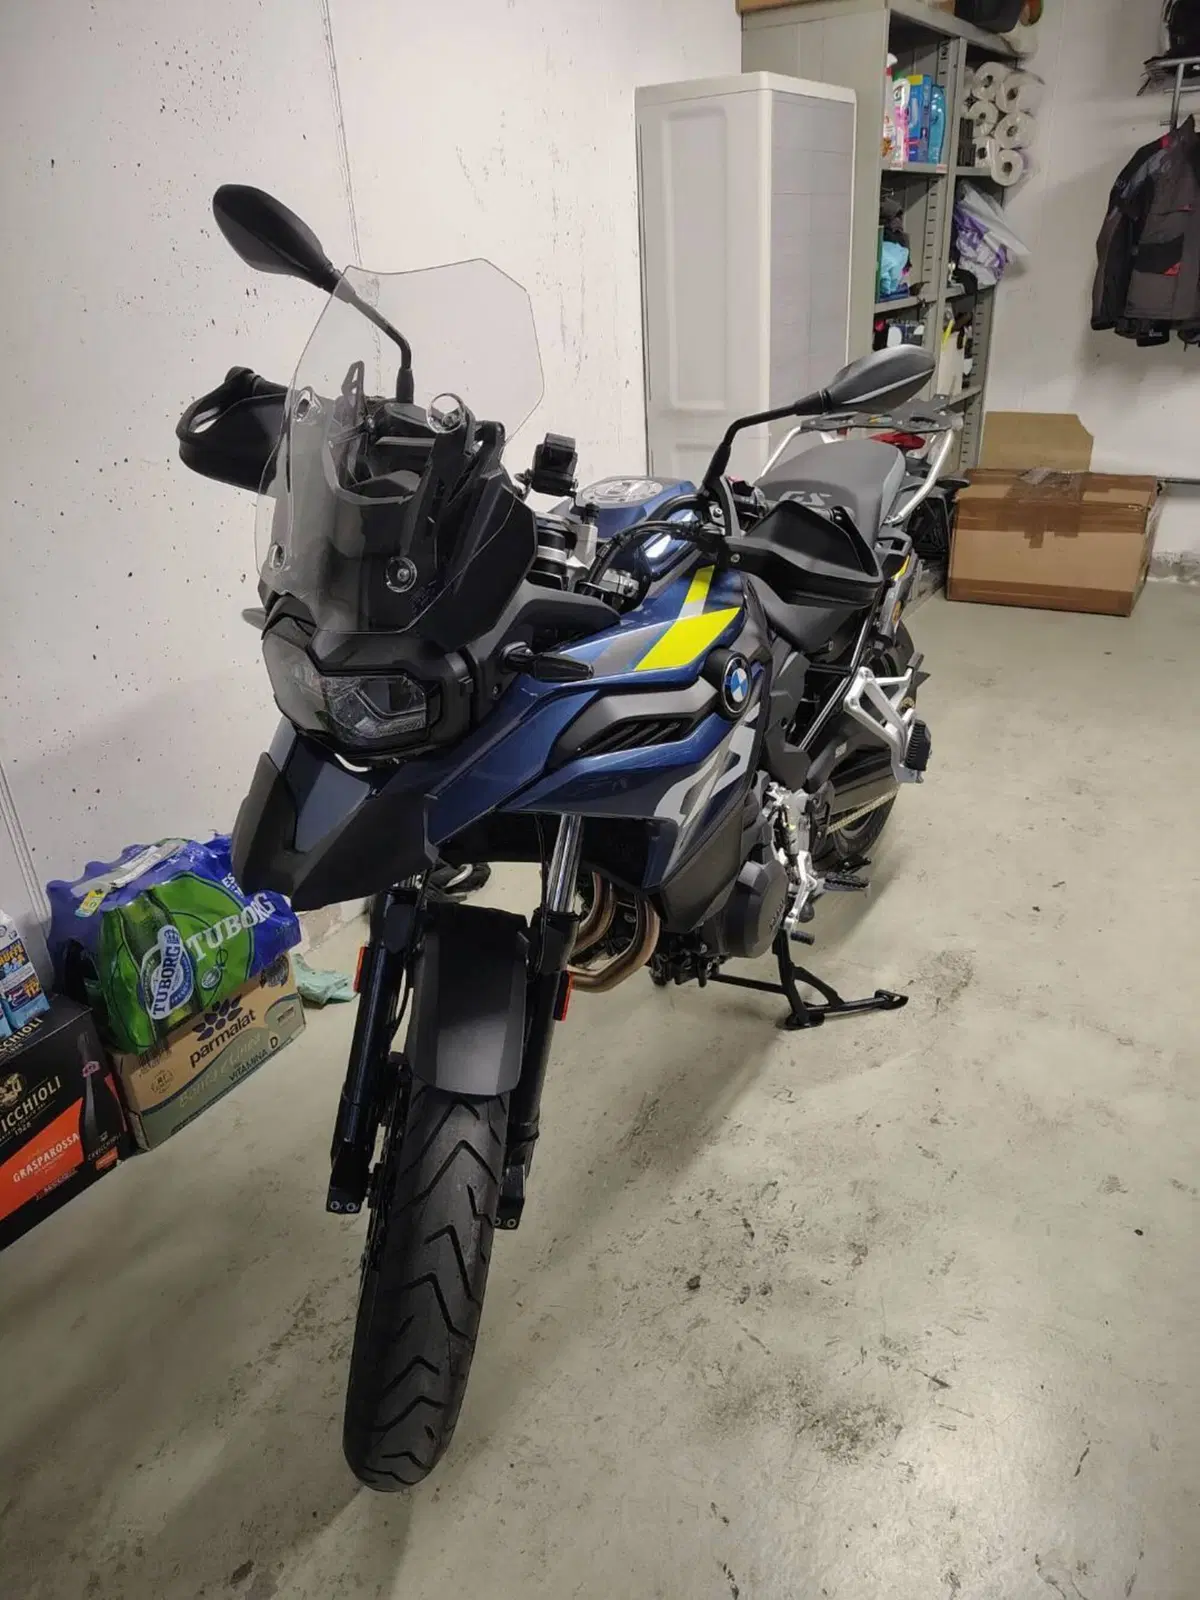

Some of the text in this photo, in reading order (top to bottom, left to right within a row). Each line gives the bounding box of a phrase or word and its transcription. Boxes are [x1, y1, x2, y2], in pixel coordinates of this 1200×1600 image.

[185, 893, 276, 962] TUBORG
[153, 944, 181, 1015] TUBORG
[189, 1009, 257, 1068] parmalat
[228, 1036, 280, 1082] VITAMINA D
[13, 1132, 80, 1183] GRASPAROSSA
